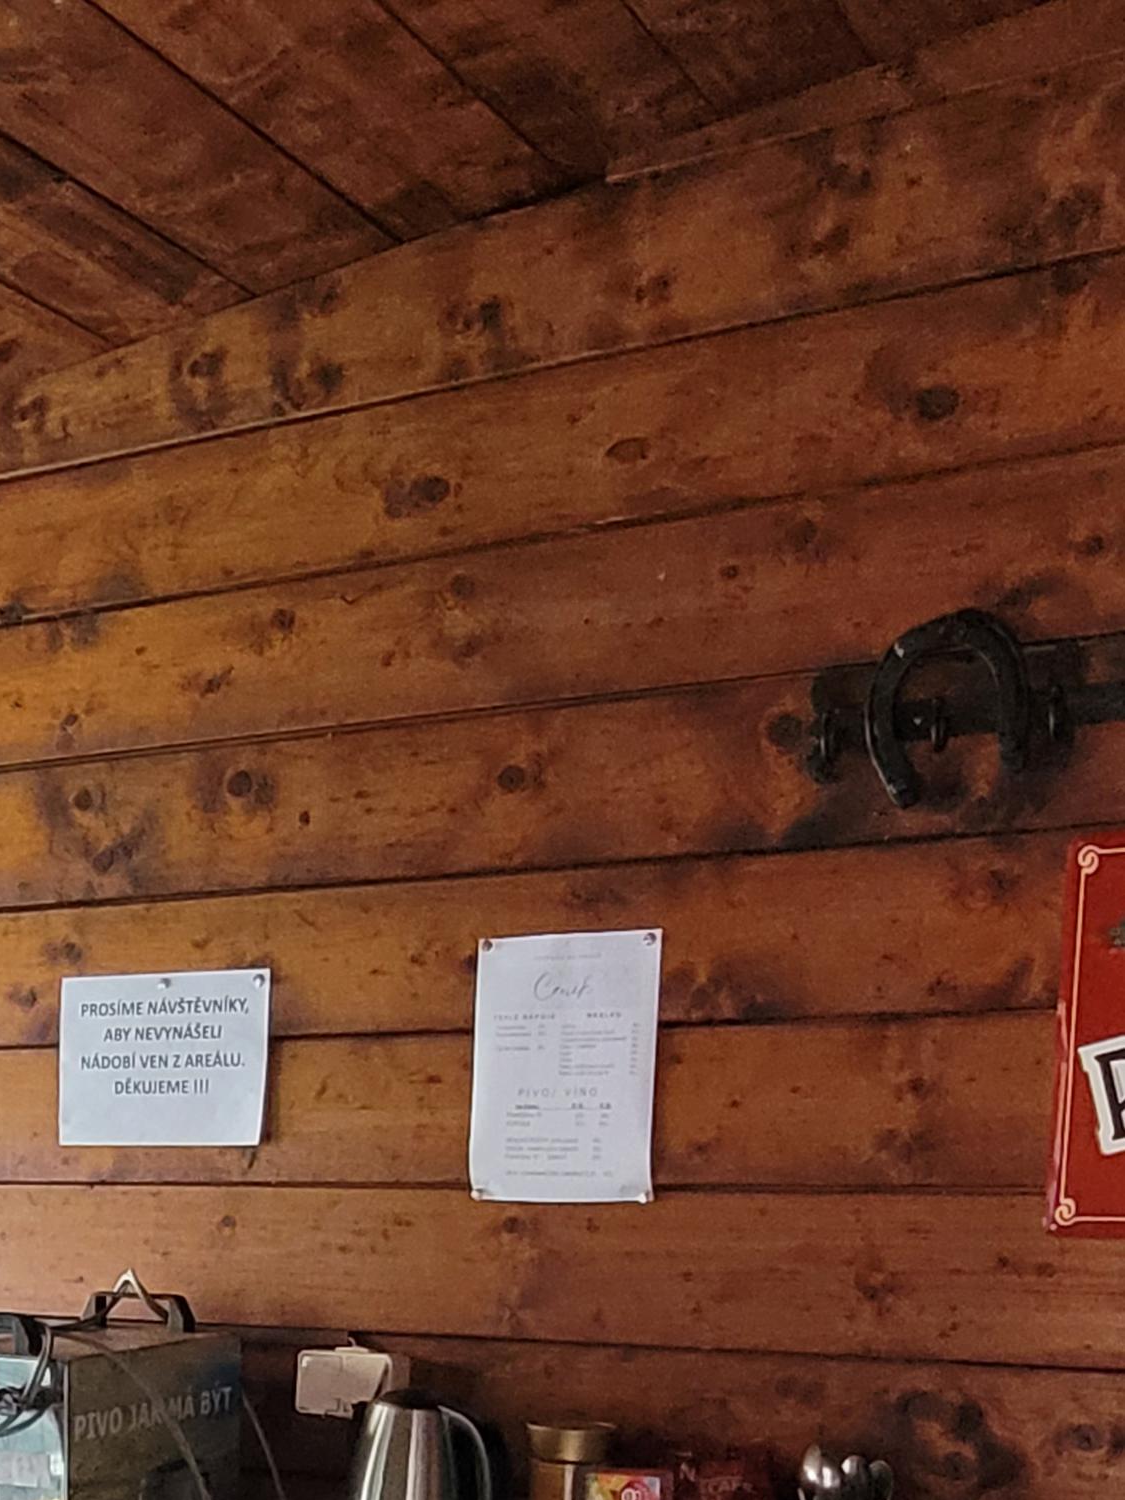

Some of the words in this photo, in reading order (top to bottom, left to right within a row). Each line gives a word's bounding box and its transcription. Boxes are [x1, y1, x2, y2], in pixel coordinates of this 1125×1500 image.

[80, 999, 143, 1018] PROSÍME
[147, 995, 249, 1016] NÁVŠTĚVNÍKY,
[103, 1027, 132, 1042] ABY
[134, 1022, 223, 1041] NEVYNÁŠELI
[81, 1053, 137, 1070] NÁDOBÍ
[140, 1054, 169, 1069] VEN
[173, 1054, 181, 1068] Z
[184, 1050, 246, 1068] AREÁLU.
[114, 1078, 190, 1095] DĚKUJEME
[74, 1406, 124, 1442] PIVO
[199, 1379, 233, 1416] BÝT
